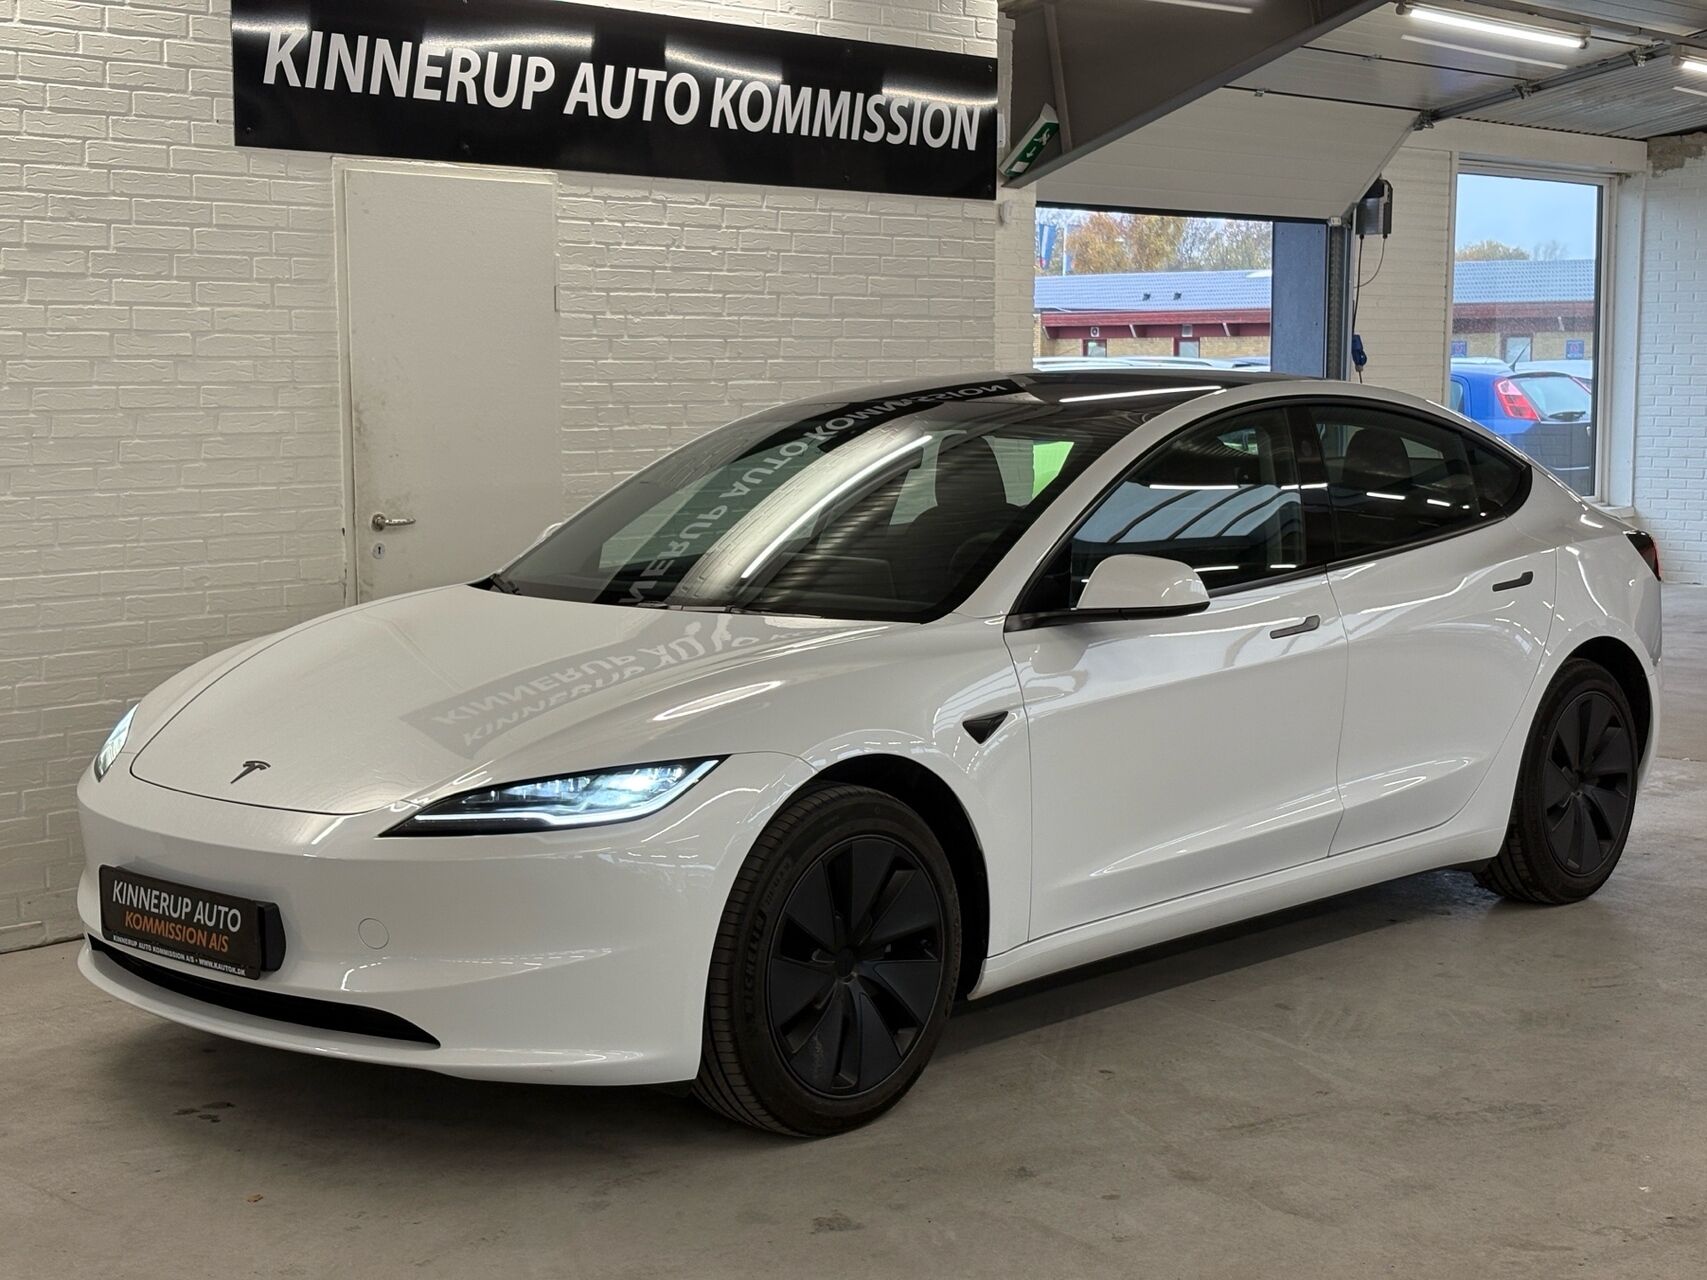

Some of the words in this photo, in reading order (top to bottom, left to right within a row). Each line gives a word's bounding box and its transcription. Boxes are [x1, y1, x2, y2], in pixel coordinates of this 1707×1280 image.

[263, 28, 555, 110] KINNERUP
[563, 62, 700, 125] AUTO
[709, 77, 981, 151] KOMMISSION
[112, 880, 192, 920] KINNERUP
[193, 901, 242, 932] AUTO
[113, 935, 138, 947] KINNERUP
[138, 942, 152, 951] AUTO
[152, 946, 185, 960] KOMMISSION
[186, 954, 195, 963] A/S
[125, 911, 208, 949] KOMMISSION
[208, 932, 229, 953] A/S
